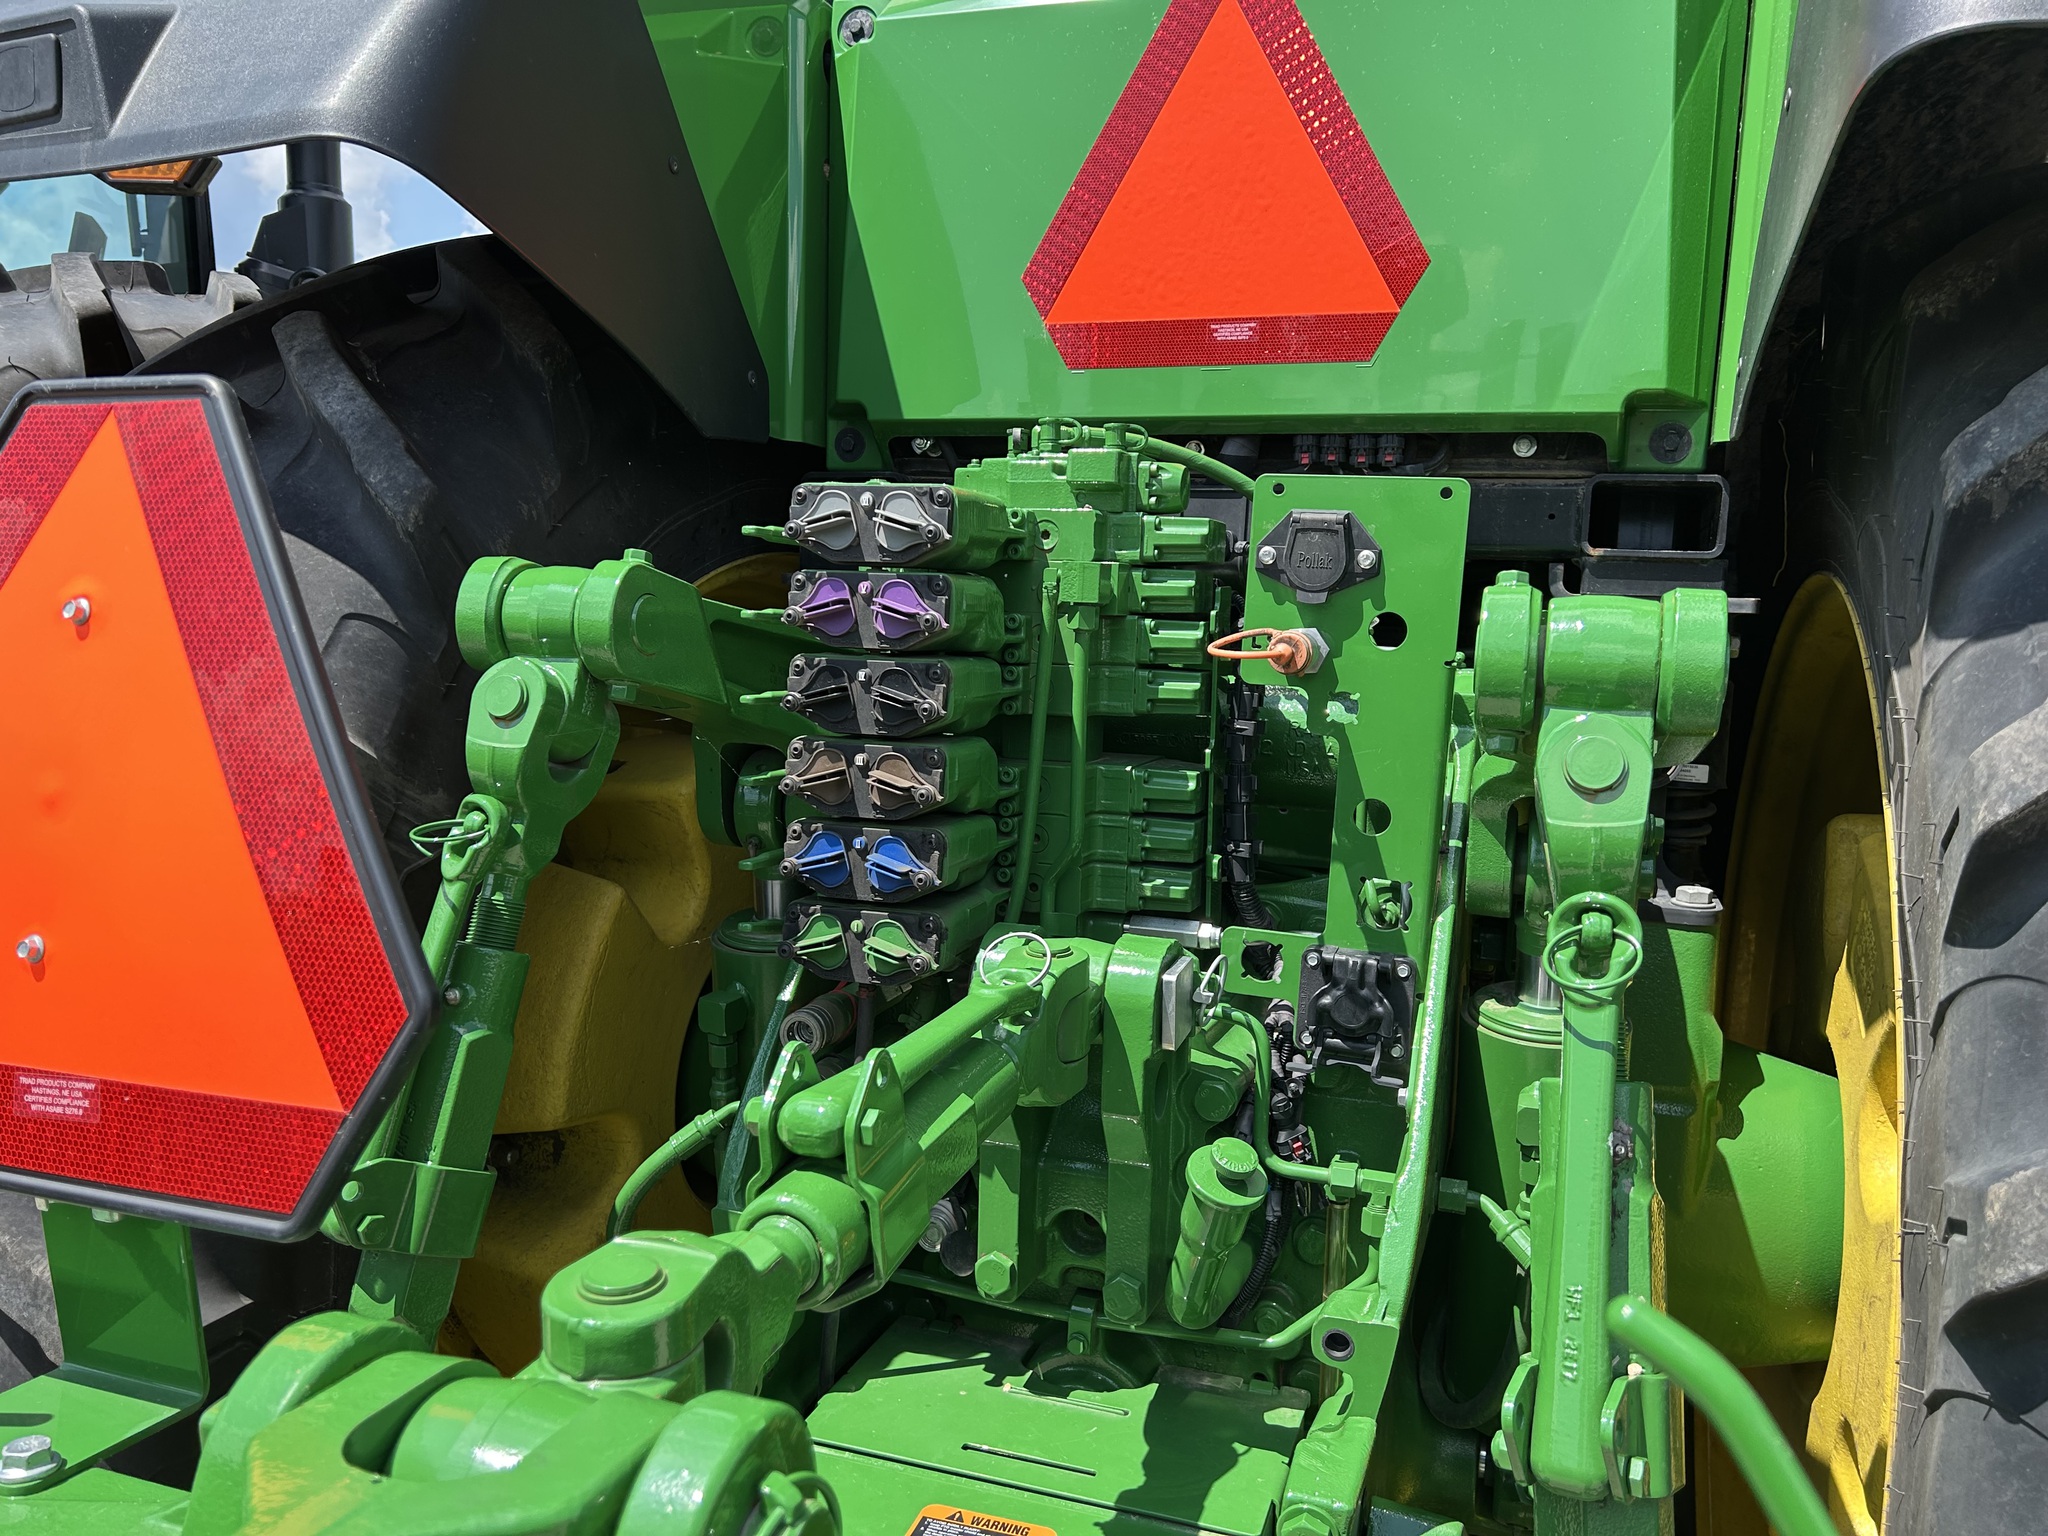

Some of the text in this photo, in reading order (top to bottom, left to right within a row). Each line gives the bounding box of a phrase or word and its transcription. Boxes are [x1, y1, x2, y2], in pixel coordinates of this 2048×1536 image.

[1297, 551, 1333, 569] Pollak
[860, 584, 867, 593] V
[856, 756, 864, 765] III
[856, 840, 860, 848] II
[19, 1077, 96, 1090] TRIAD PRODUCTS COMPANY
[32, 1087, 60, 1096] HASTINGS,
[24, 1095, 90, 1107] CERTIFIES COMPLIANCE
[970, 1516, 1031, 1536] WARNING
